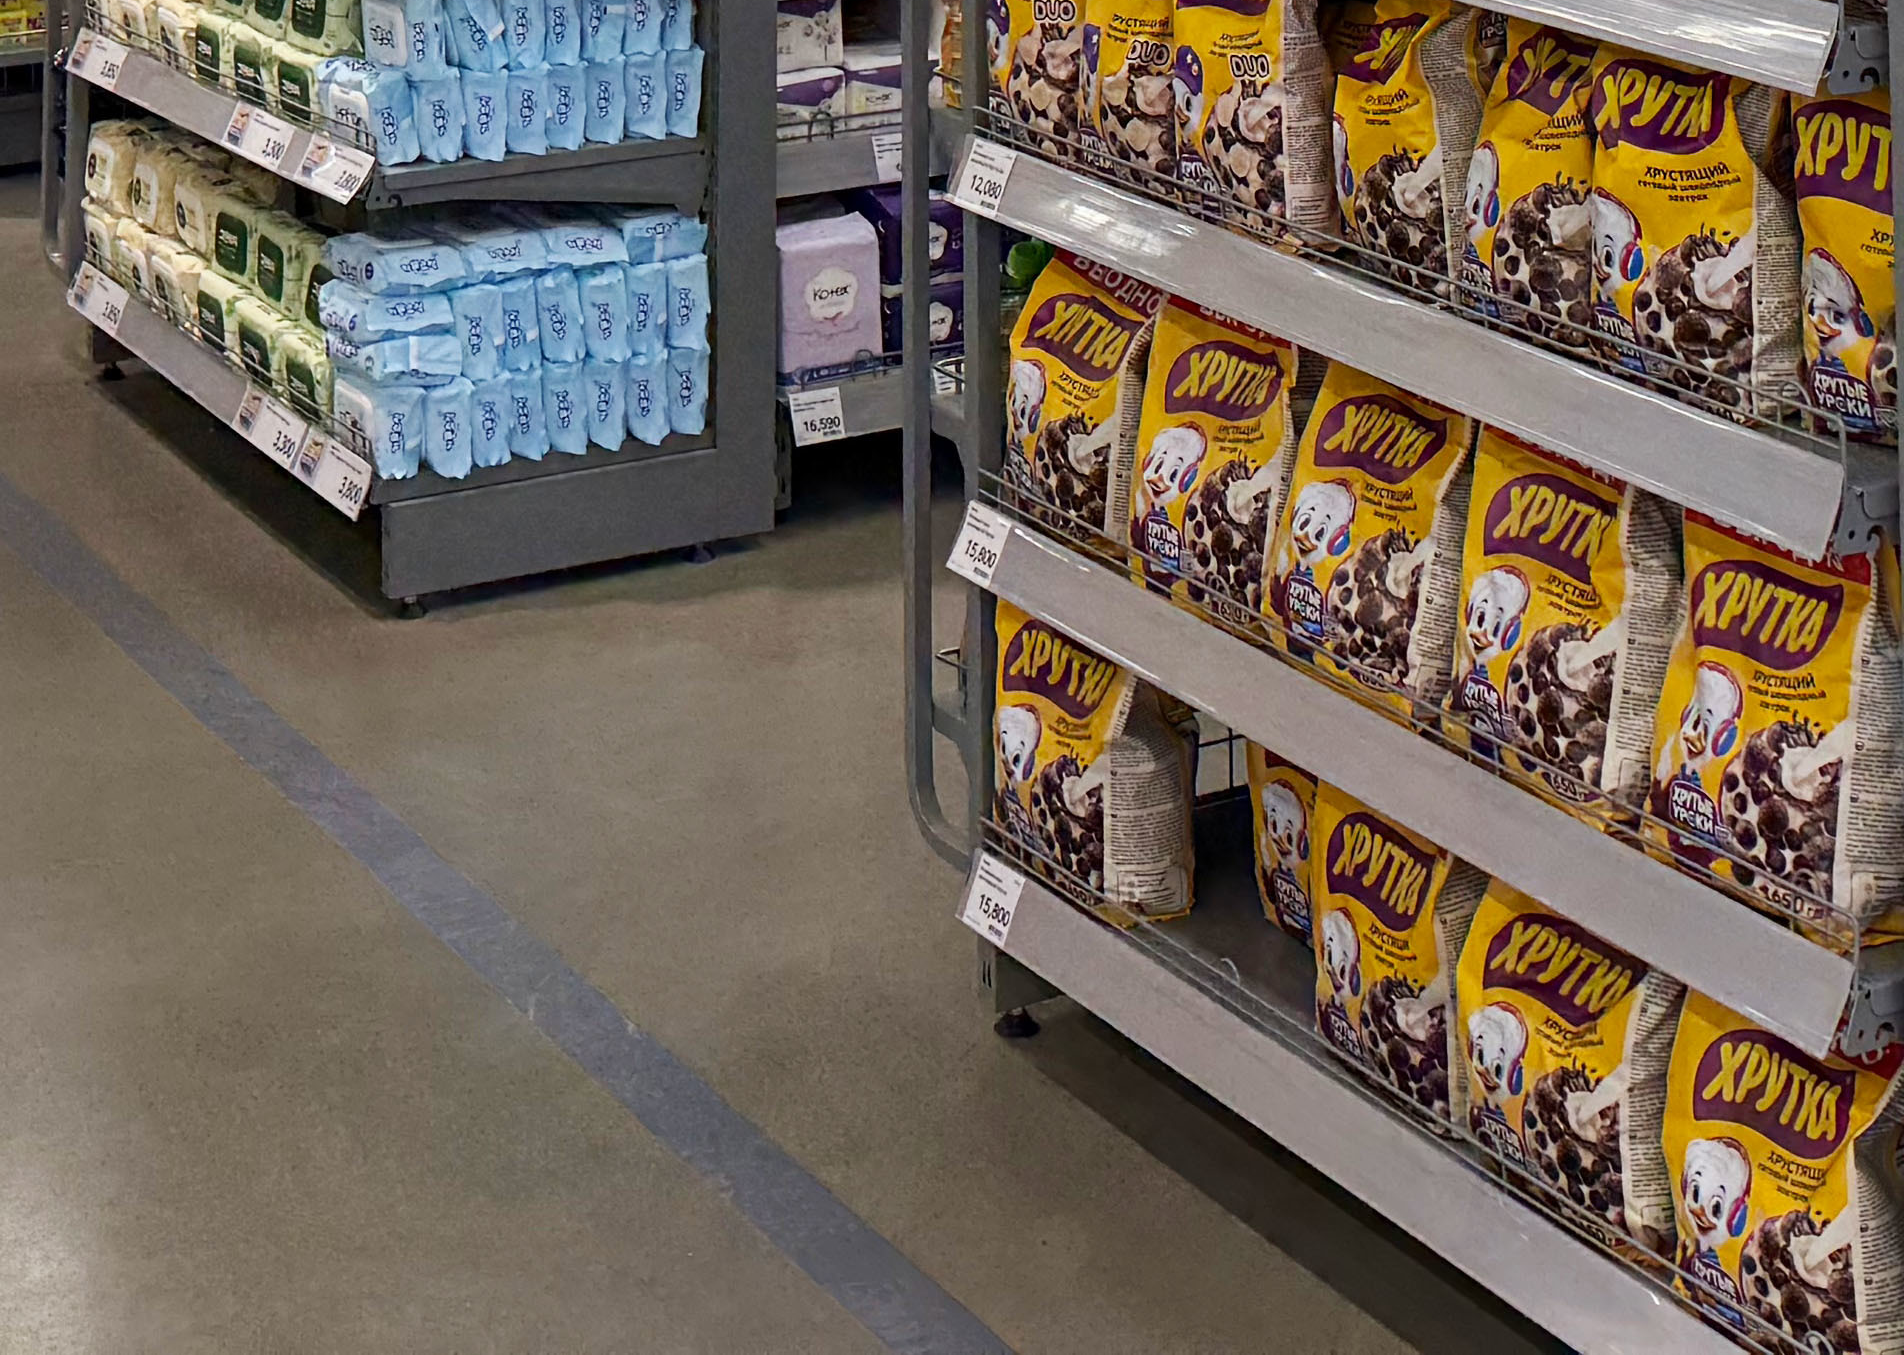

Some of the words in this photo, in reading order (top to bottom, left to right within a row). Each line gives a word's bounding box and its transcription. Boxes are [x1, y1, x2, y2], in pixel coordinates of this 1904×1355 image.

[1228, 53, 1270, 80] DUO
[1695, 571, 1829, 653] ХРУТКА
[1699, 1038, 1850, 1143] ХРУТКА
